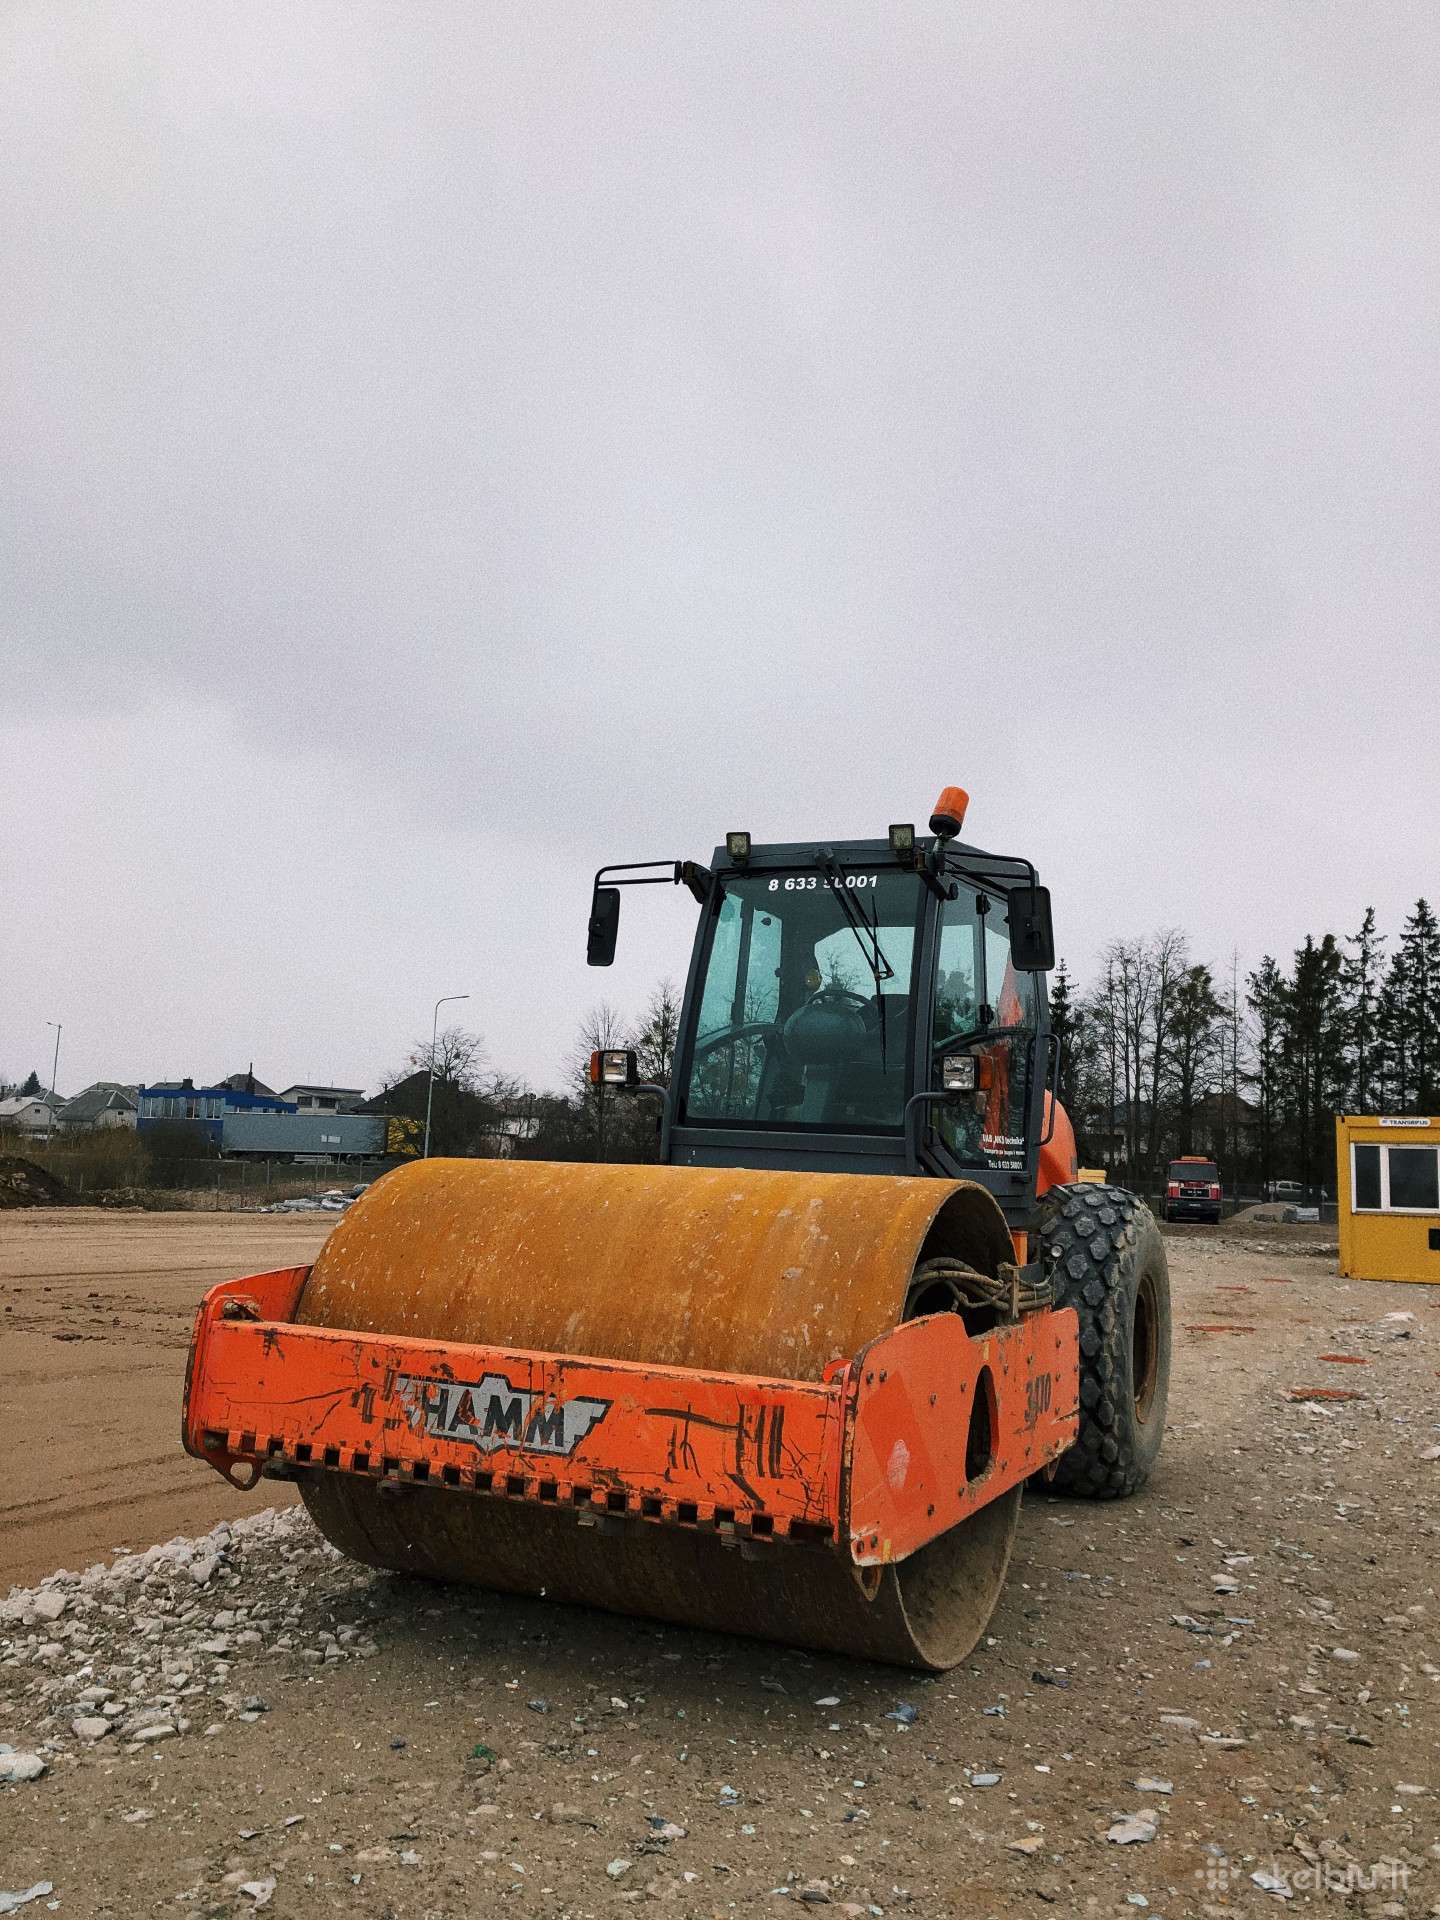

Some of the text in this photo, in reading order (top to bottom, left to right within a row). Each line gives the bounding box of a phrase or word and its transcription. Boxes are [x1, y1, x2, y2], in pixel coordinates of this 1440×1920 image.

[768, 879, 779, 891] 8
[784, 877, 817, 890] 633
[421, 1384, 564, 1447] HAMM
